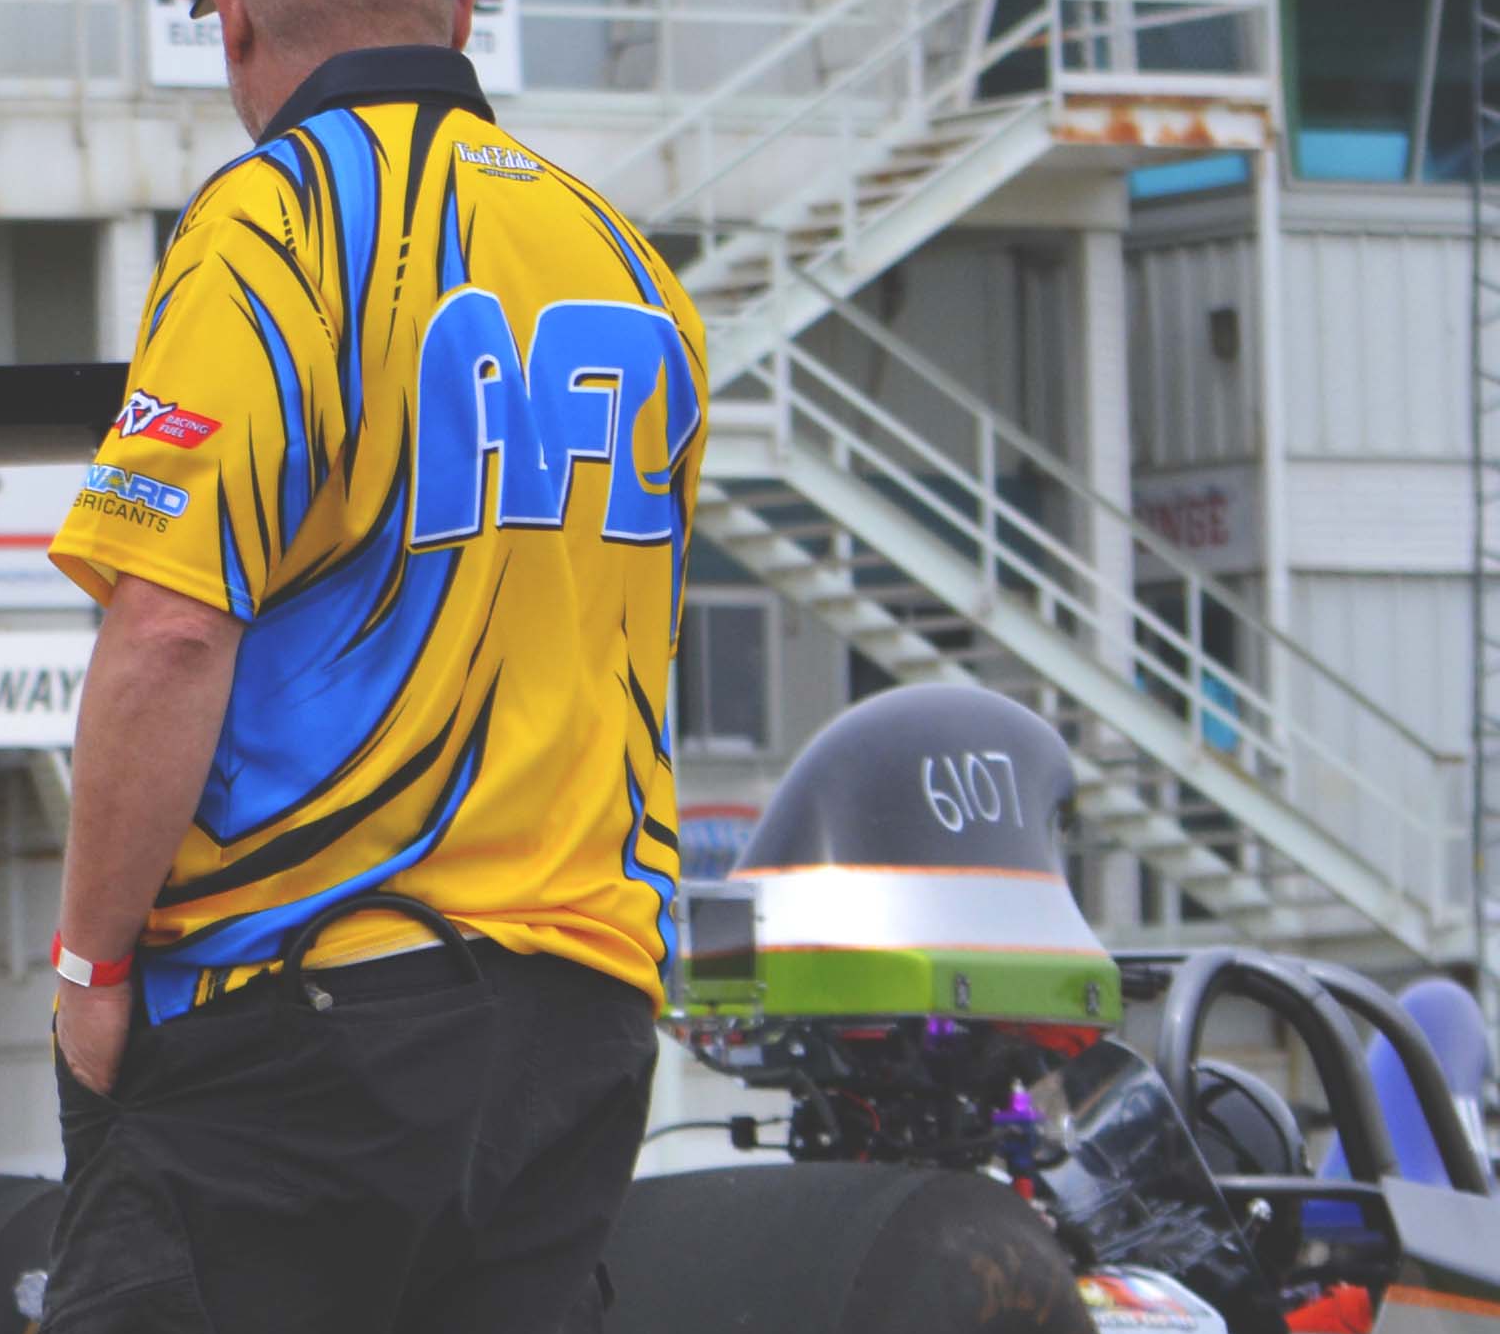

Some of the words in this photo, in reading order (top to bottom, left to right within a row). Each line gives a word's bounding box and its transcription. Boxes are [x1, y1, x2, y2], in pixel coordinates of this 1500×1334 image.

[171, 24, 224, 45] ELEC
[116, 389, 177, 438] RY
[158, 424, 185, 438] FUEL
[165, 415, 209, 434] RACING
[85, 464, 190, 518] WARD
[73, 493, 169, 533] BRICANTS
[922, 751, 1026, 834] 6107
